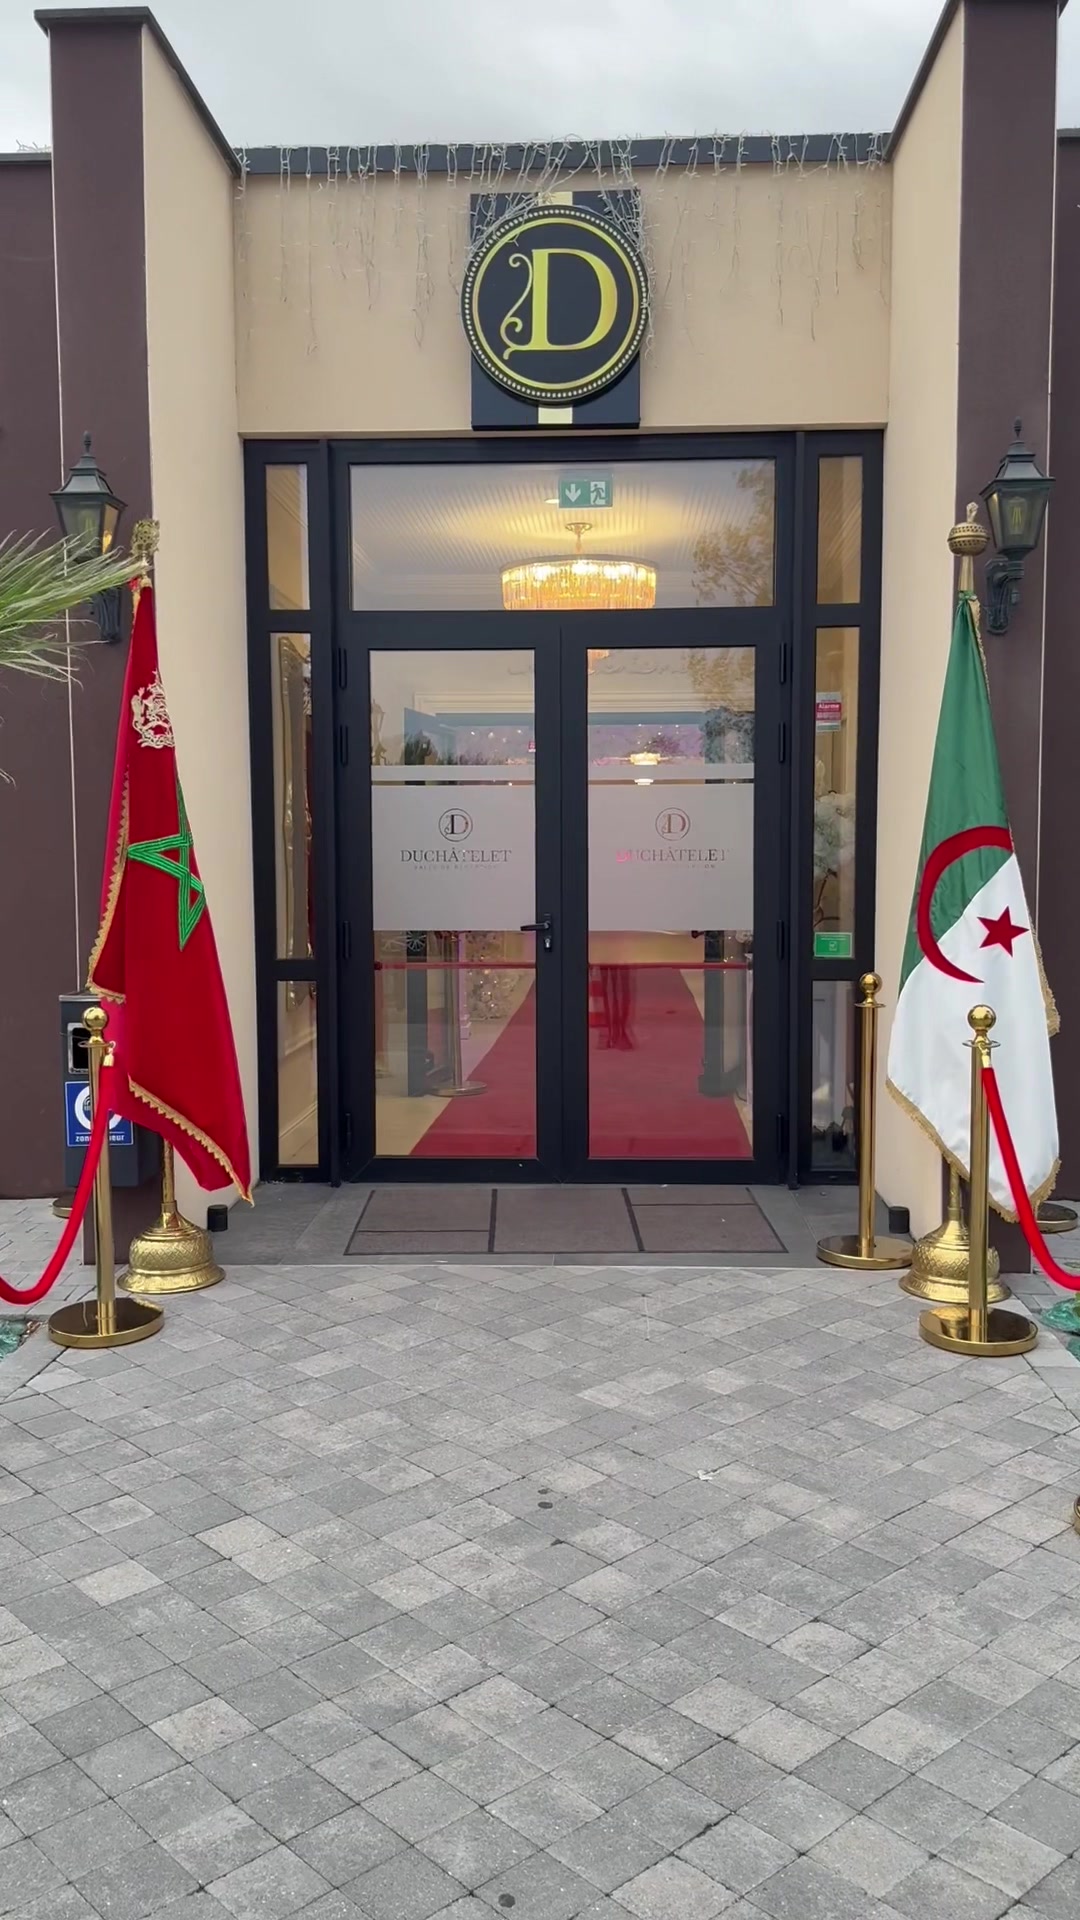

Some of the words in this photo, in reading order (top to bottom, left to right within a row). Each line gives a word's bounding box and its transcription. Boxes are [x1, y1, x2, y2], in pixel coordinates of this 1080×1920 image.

[503, 248, 618, 358] D
[446, 814, 469, 835] D
[401, 847, 512, 862] DUCHÂTELET
